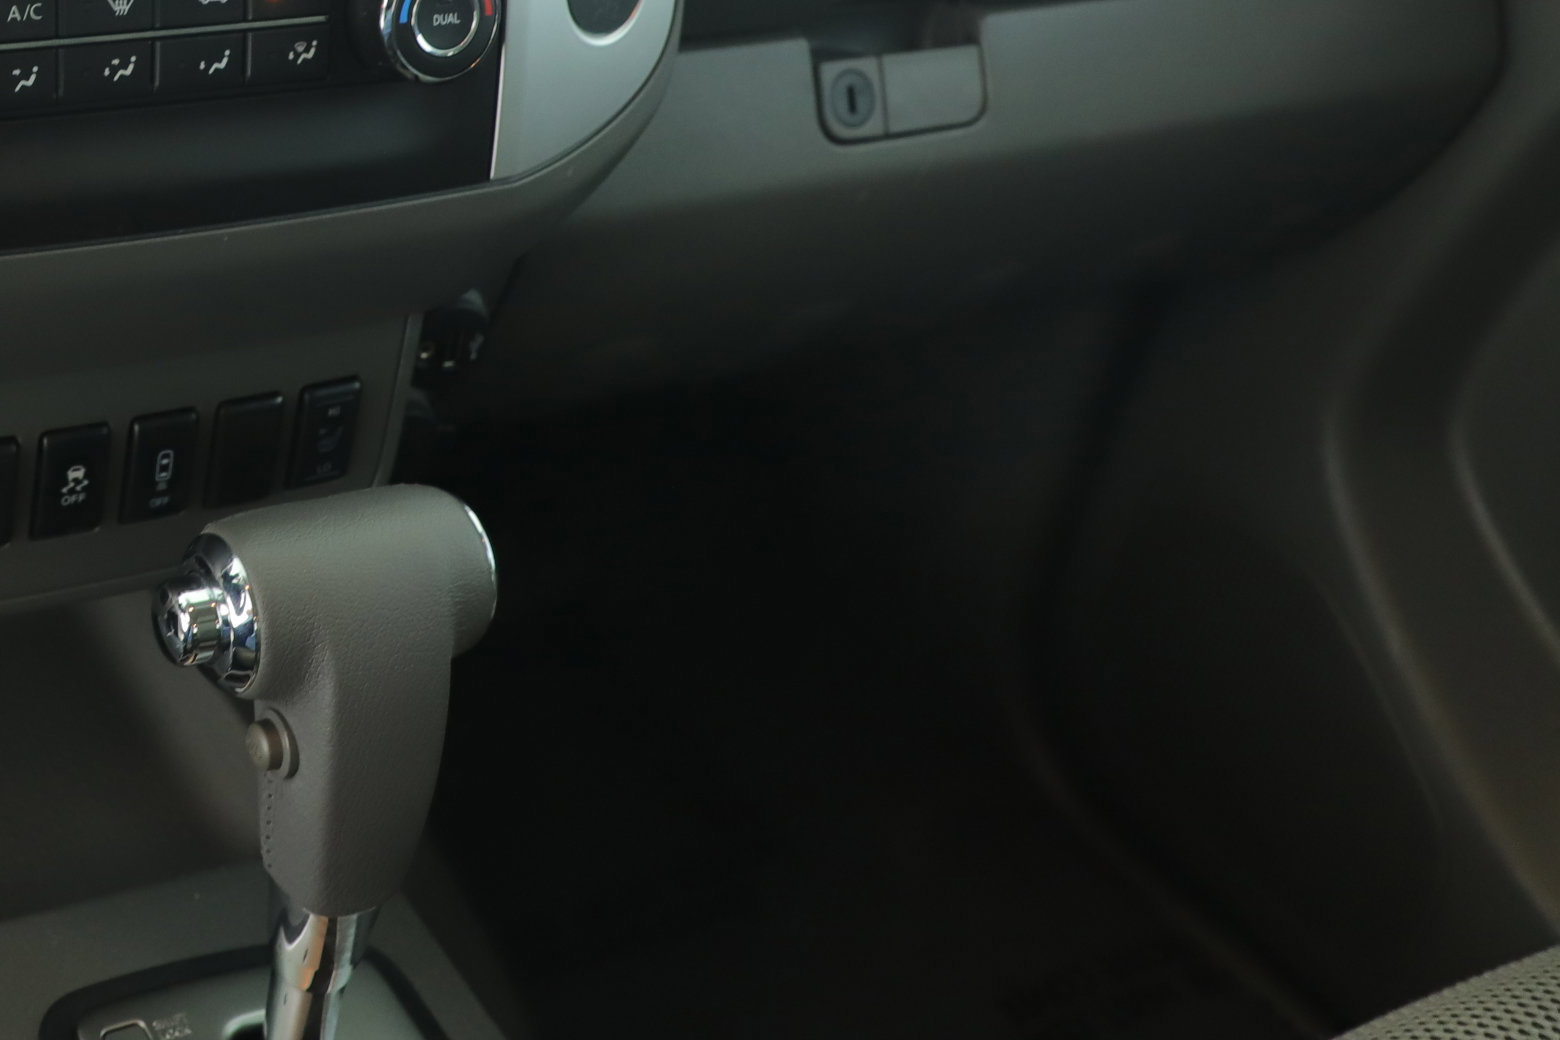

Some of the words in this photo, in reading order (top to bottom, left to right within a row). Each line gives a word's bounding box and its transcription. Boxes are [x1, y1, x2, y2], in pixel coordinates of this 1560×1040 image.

[8, 2, 42, 23] A/C
[432, 11, 461, 26] DUAL
[60, 492, 87, 506] OFF
